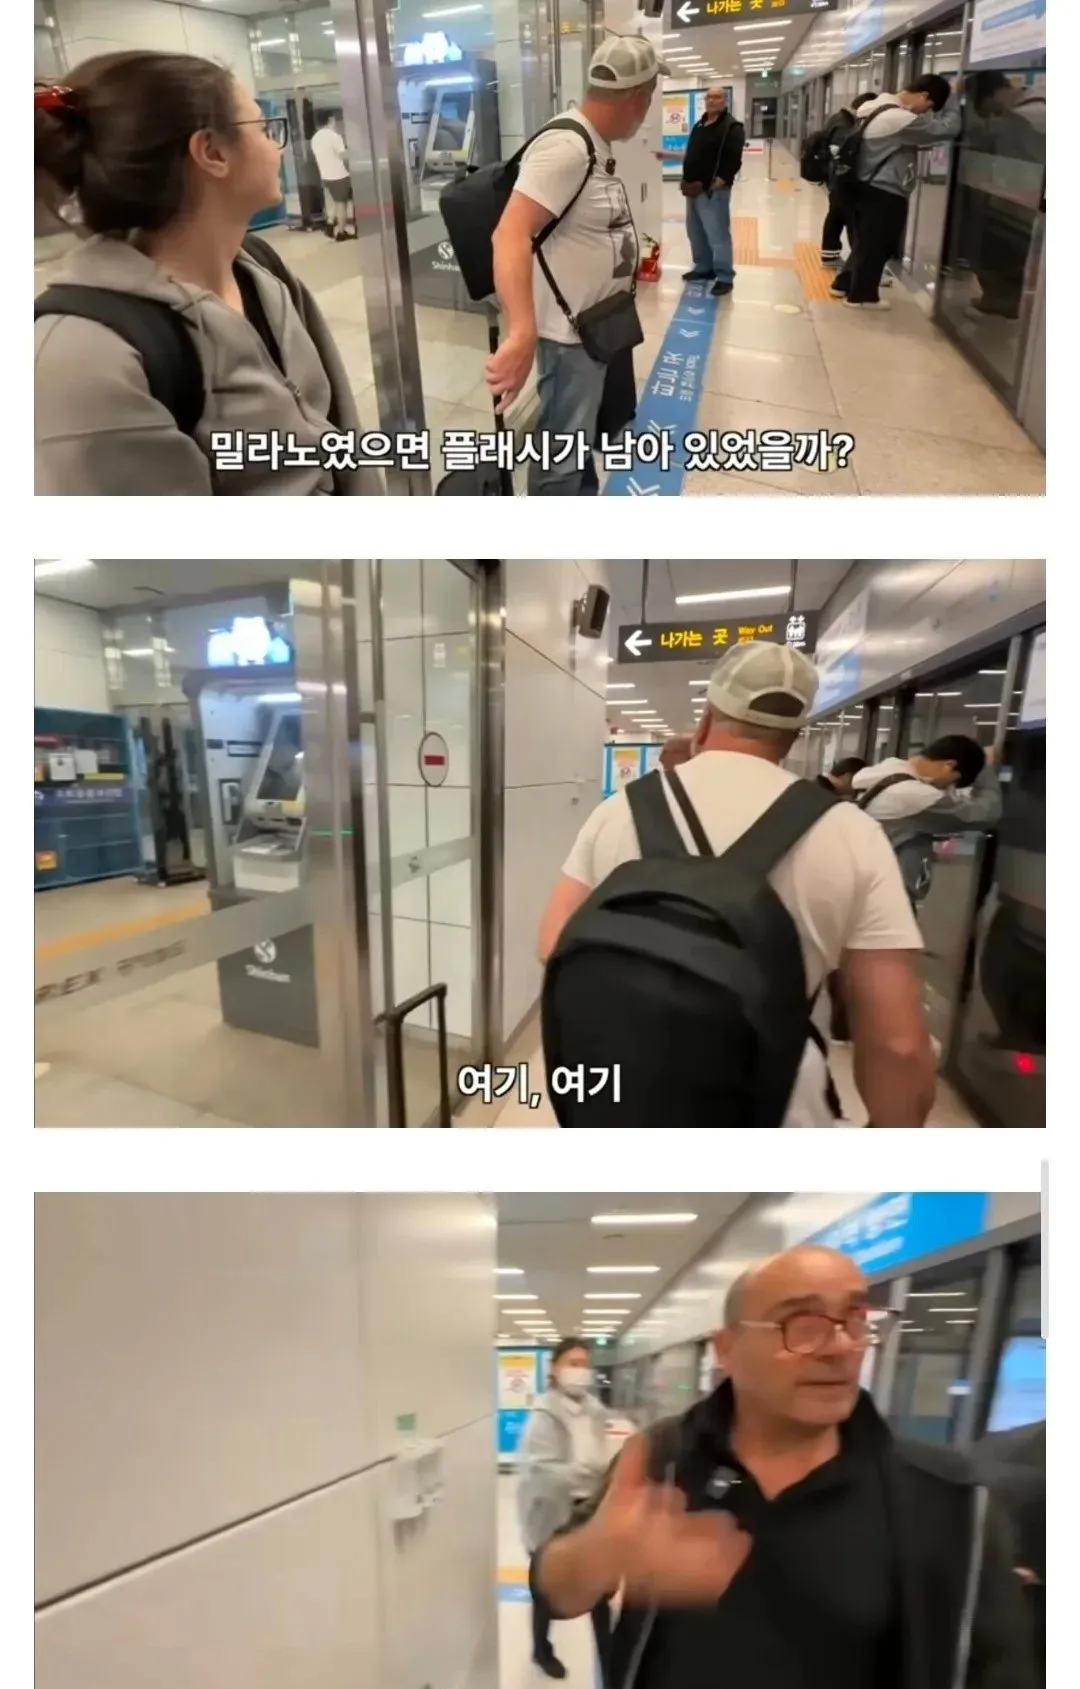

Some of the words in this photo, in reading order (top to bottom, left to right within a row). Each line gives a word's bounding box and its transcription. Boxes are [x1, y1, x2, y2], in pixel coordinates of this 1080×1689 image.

[431, 260, 460, 272] Shinha
[660, 630, 703, 648] 나가는
[712, 628, 729, 645] 곳
